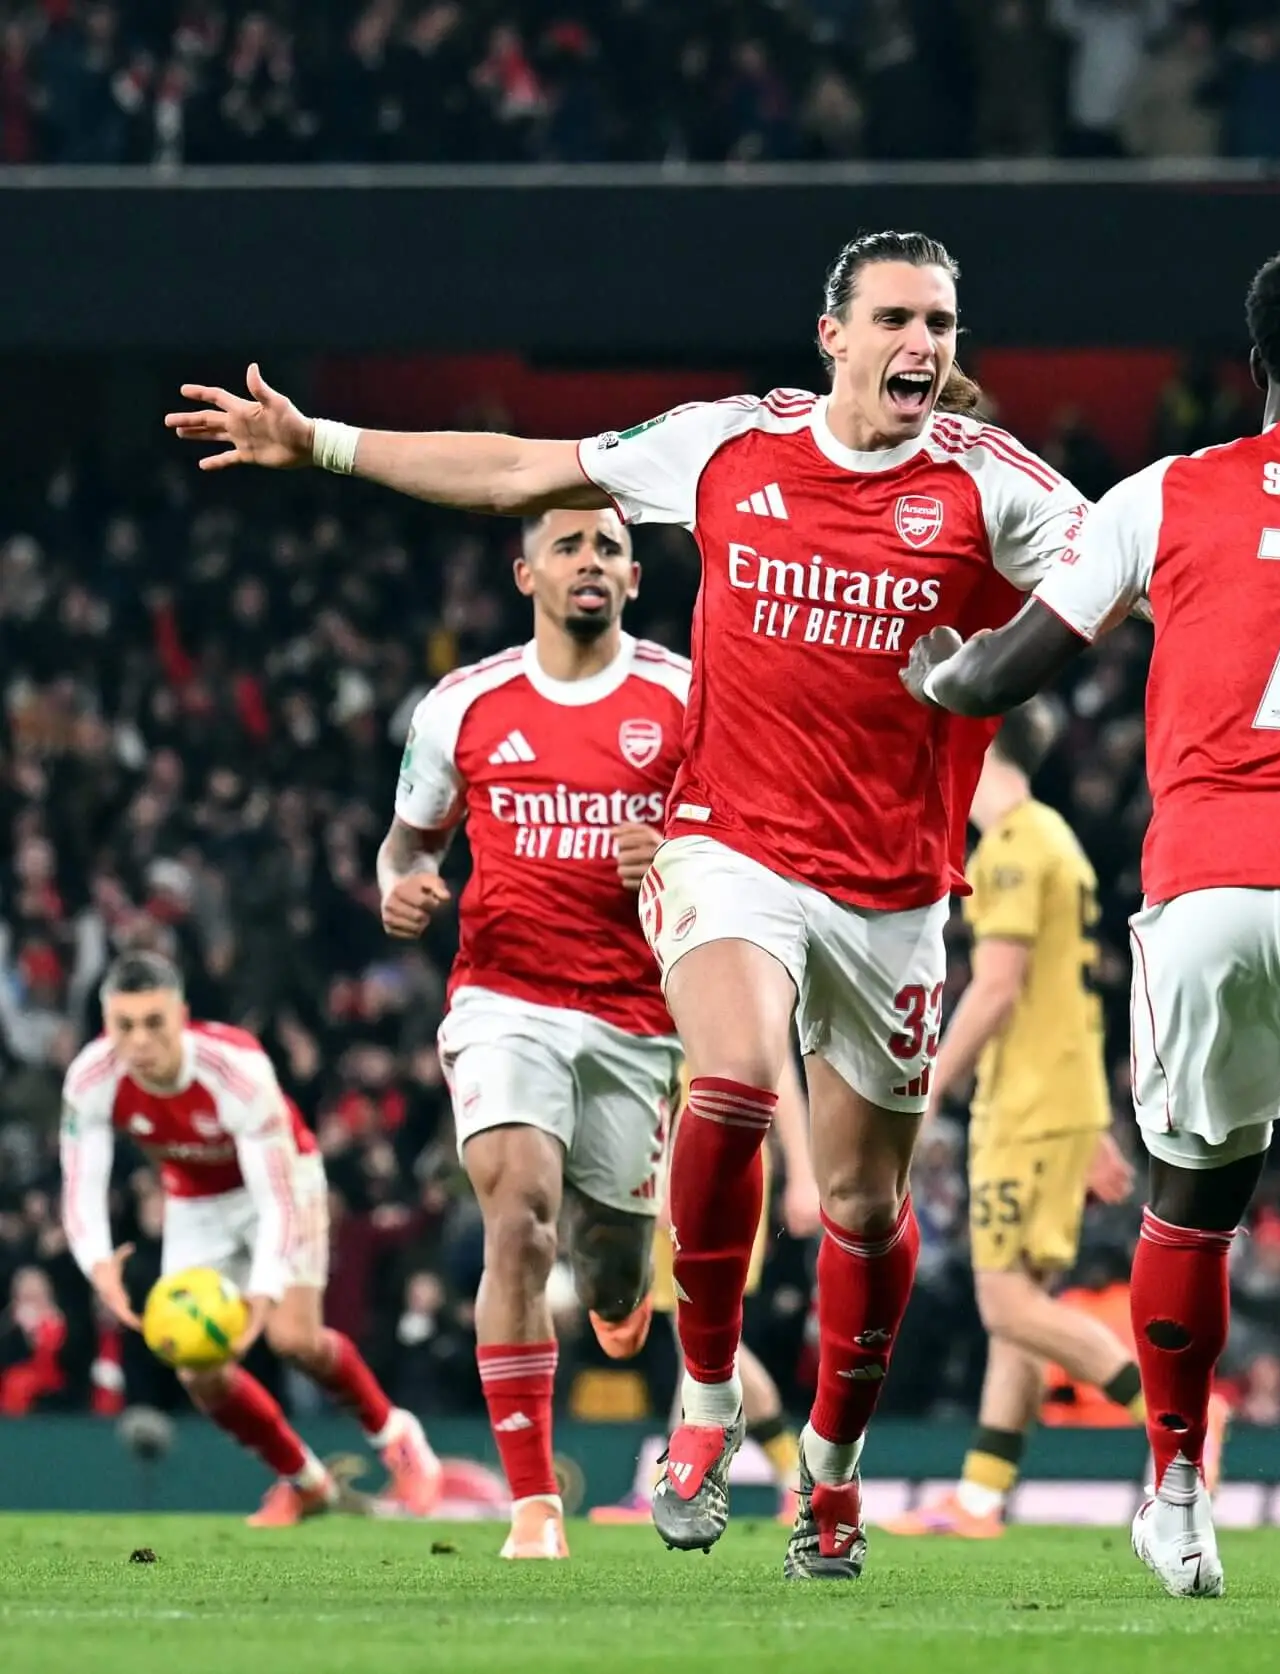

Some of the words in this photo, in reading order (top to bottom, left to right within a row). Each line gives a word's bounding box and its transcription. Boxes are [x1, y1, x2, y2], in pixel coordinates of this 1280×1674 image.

[902, 503, 937, 515] Arsenal
[728, 542, 941, 612] Emirates
[752, 599, 799, 639] FLY
[803, 607, 905, 651] BETTER
[488, 784, 664, 825] Emirates
[514, 826, 553, 859] FLY
